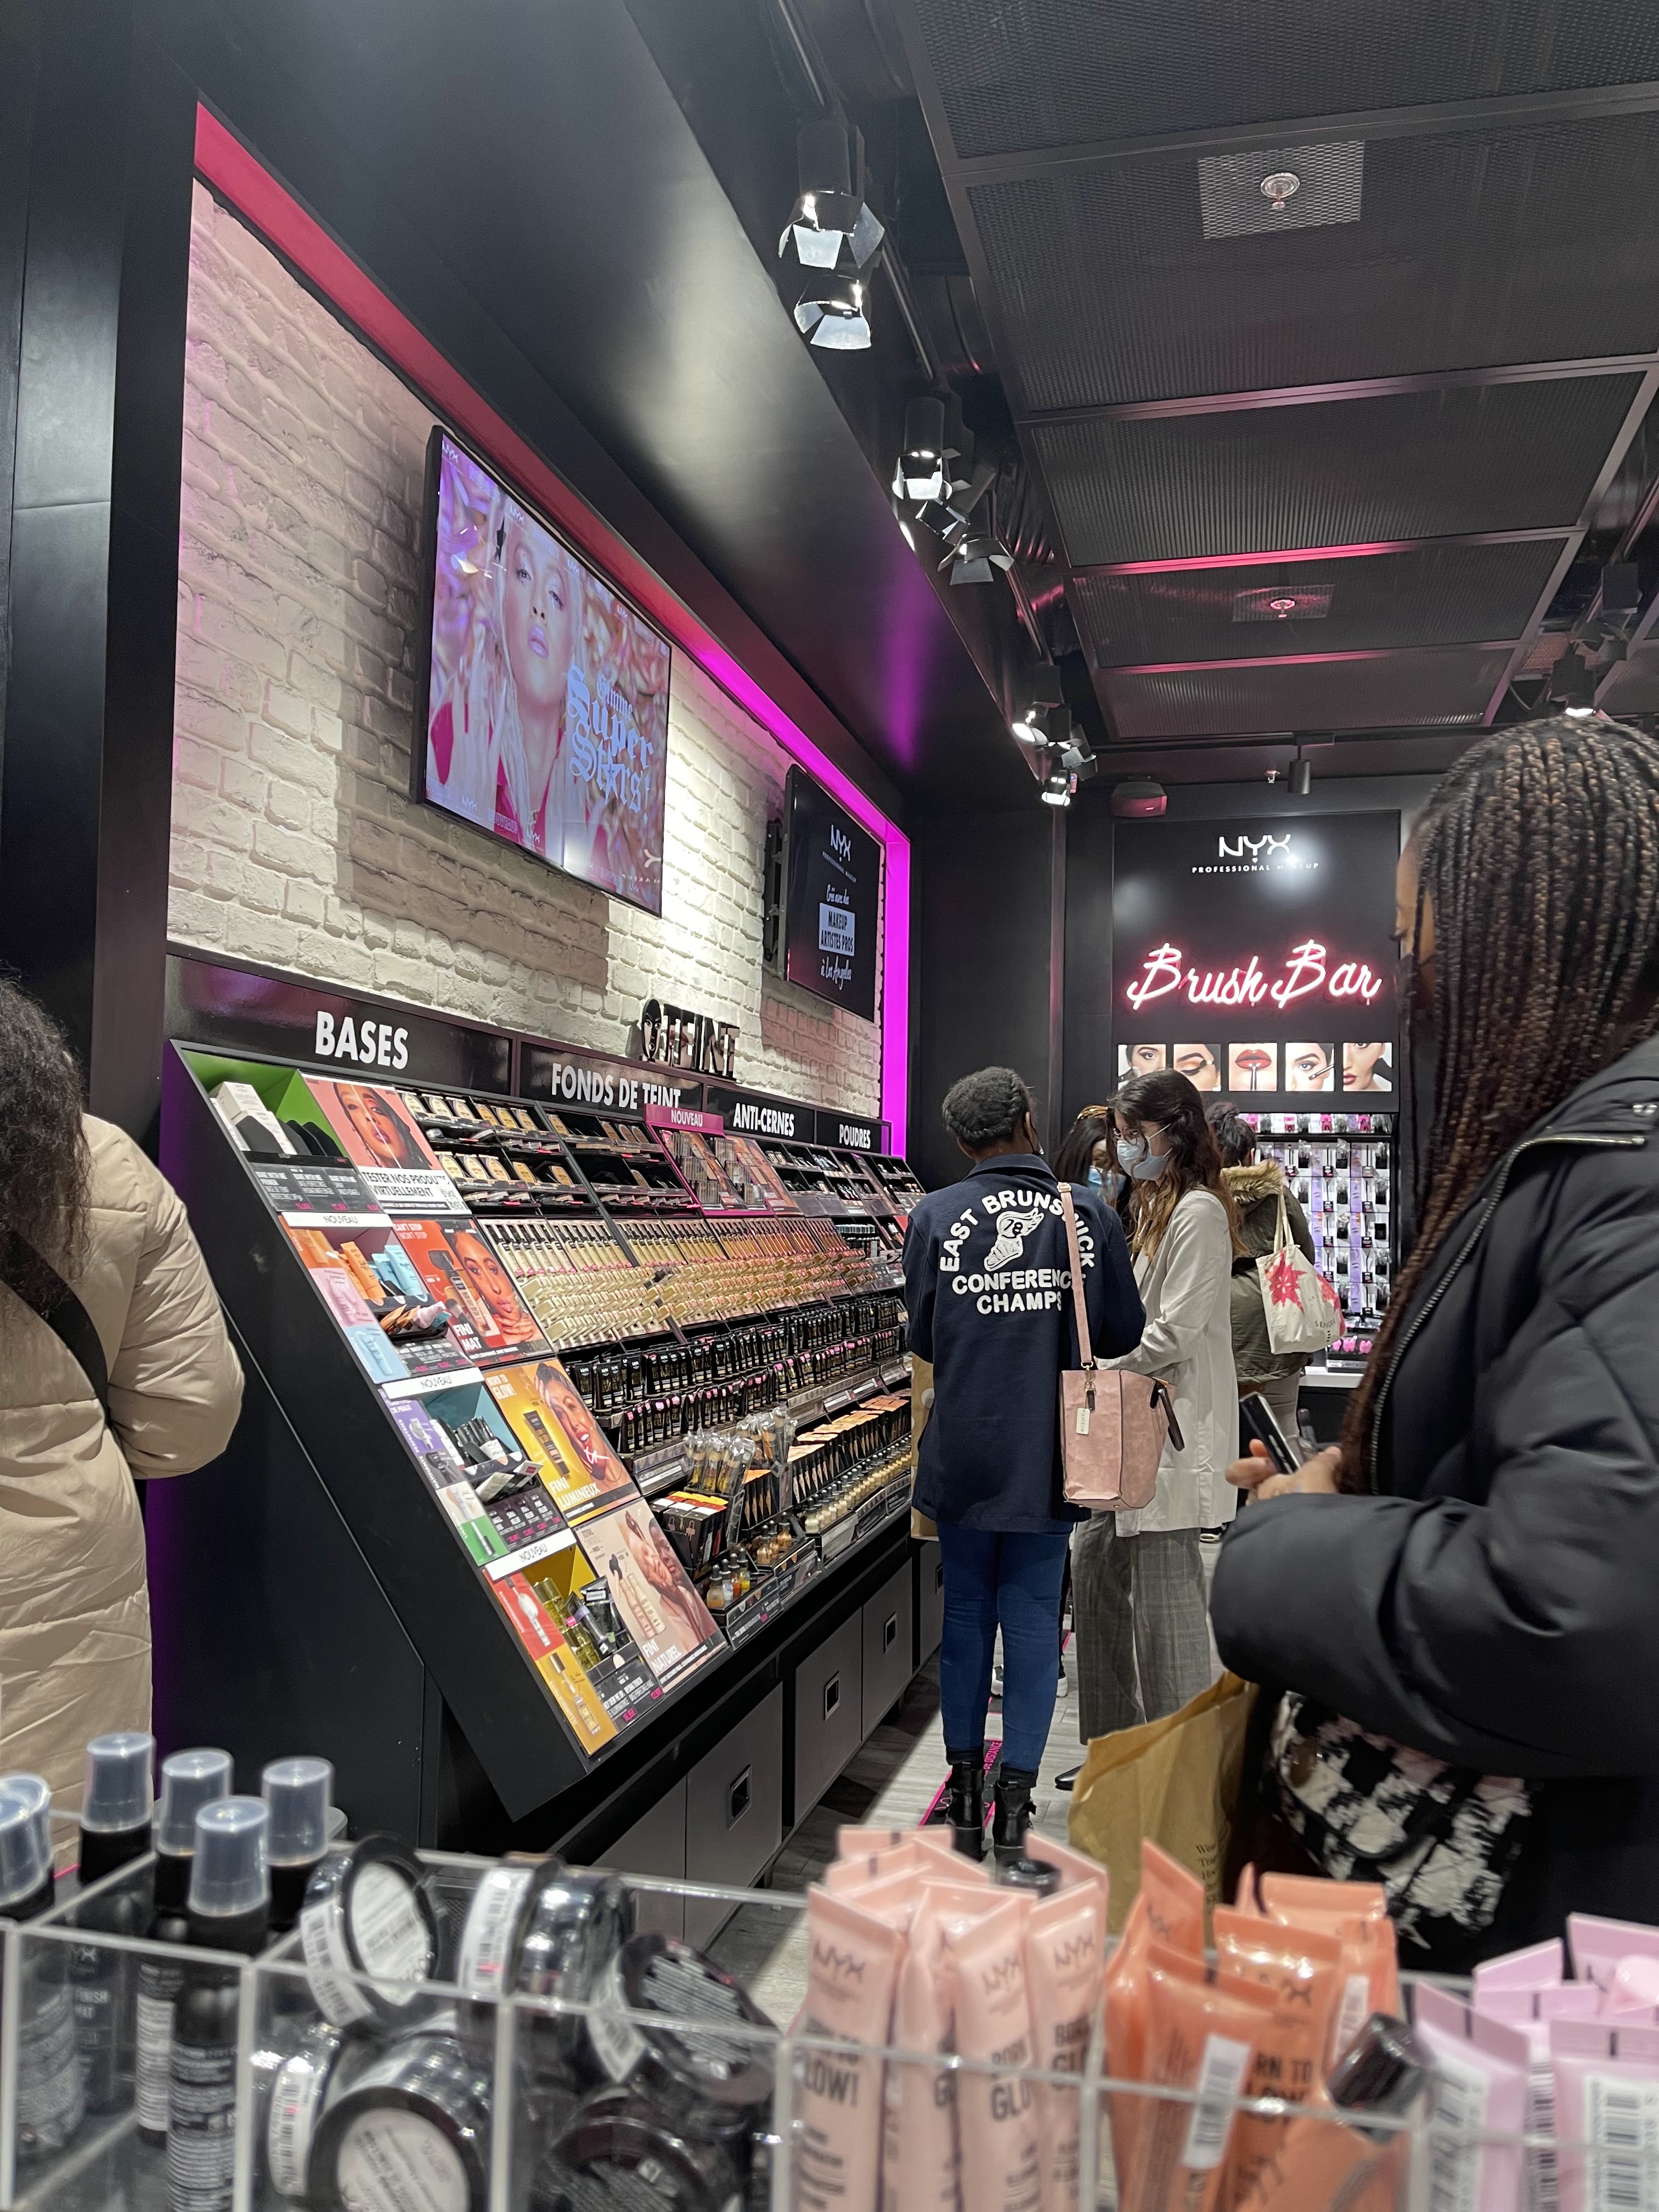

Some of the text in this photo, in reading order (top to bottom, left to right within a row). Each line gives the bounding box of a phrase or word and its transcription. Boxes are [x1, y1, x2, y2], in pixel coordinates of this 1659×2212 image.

[568, 663, 654, 769] Super
[831, 825, 851, 862] NYX
[1219, 834, 1291, 857] NYX
[1192, 865, 1271, 873] PROFESSIONAL
[827, 910, 848, 931] MAKEUP
[820, 929, 854, 953] ARTISTES PROS
[1126, 939, 1383, 1011] Brush Bar
[315, 1011, 409, 1069] BASES
[551, 1063, 681, 1109] FONDS DE TEINT
[671, 1110, 703, 1127] NOUVEAU
[733, 1103, 795, 1137] ANTI-CERNES
[839, 1124, 871, 1150] POUDRES
[361, 1172, 446, 1185] TESTER NOS PRODUS
[369, 1185, 434, 1197] VIRTUELLEMENT
[323, 1215, 358, 1224] NOUVEAU
[939, 1189, 1096, 1272] EAST BRUNSICK
[952, 1268, 1086, 1295] CONFERENC
[977, 1291, 1062, 1315] CHAMPS
[453, 1323, 474, 1337] FINI
[461, 1336, 482, 1351] MAT
[420, 1375, 452, 1389] NOUVEAU
[548, 1477, 571, 1494] FINI
[557, 1481, 601, 1508] LUMINEUX
[518, 1542, 548, 1564] NOUVEAU
[642, 1639, 659, 1658] FINI
[651, 1644, 682, 1674] NATUREL
[812, 1938, 866, 1984] NYX
[1053, 1930, 1097, 1969] NYX
